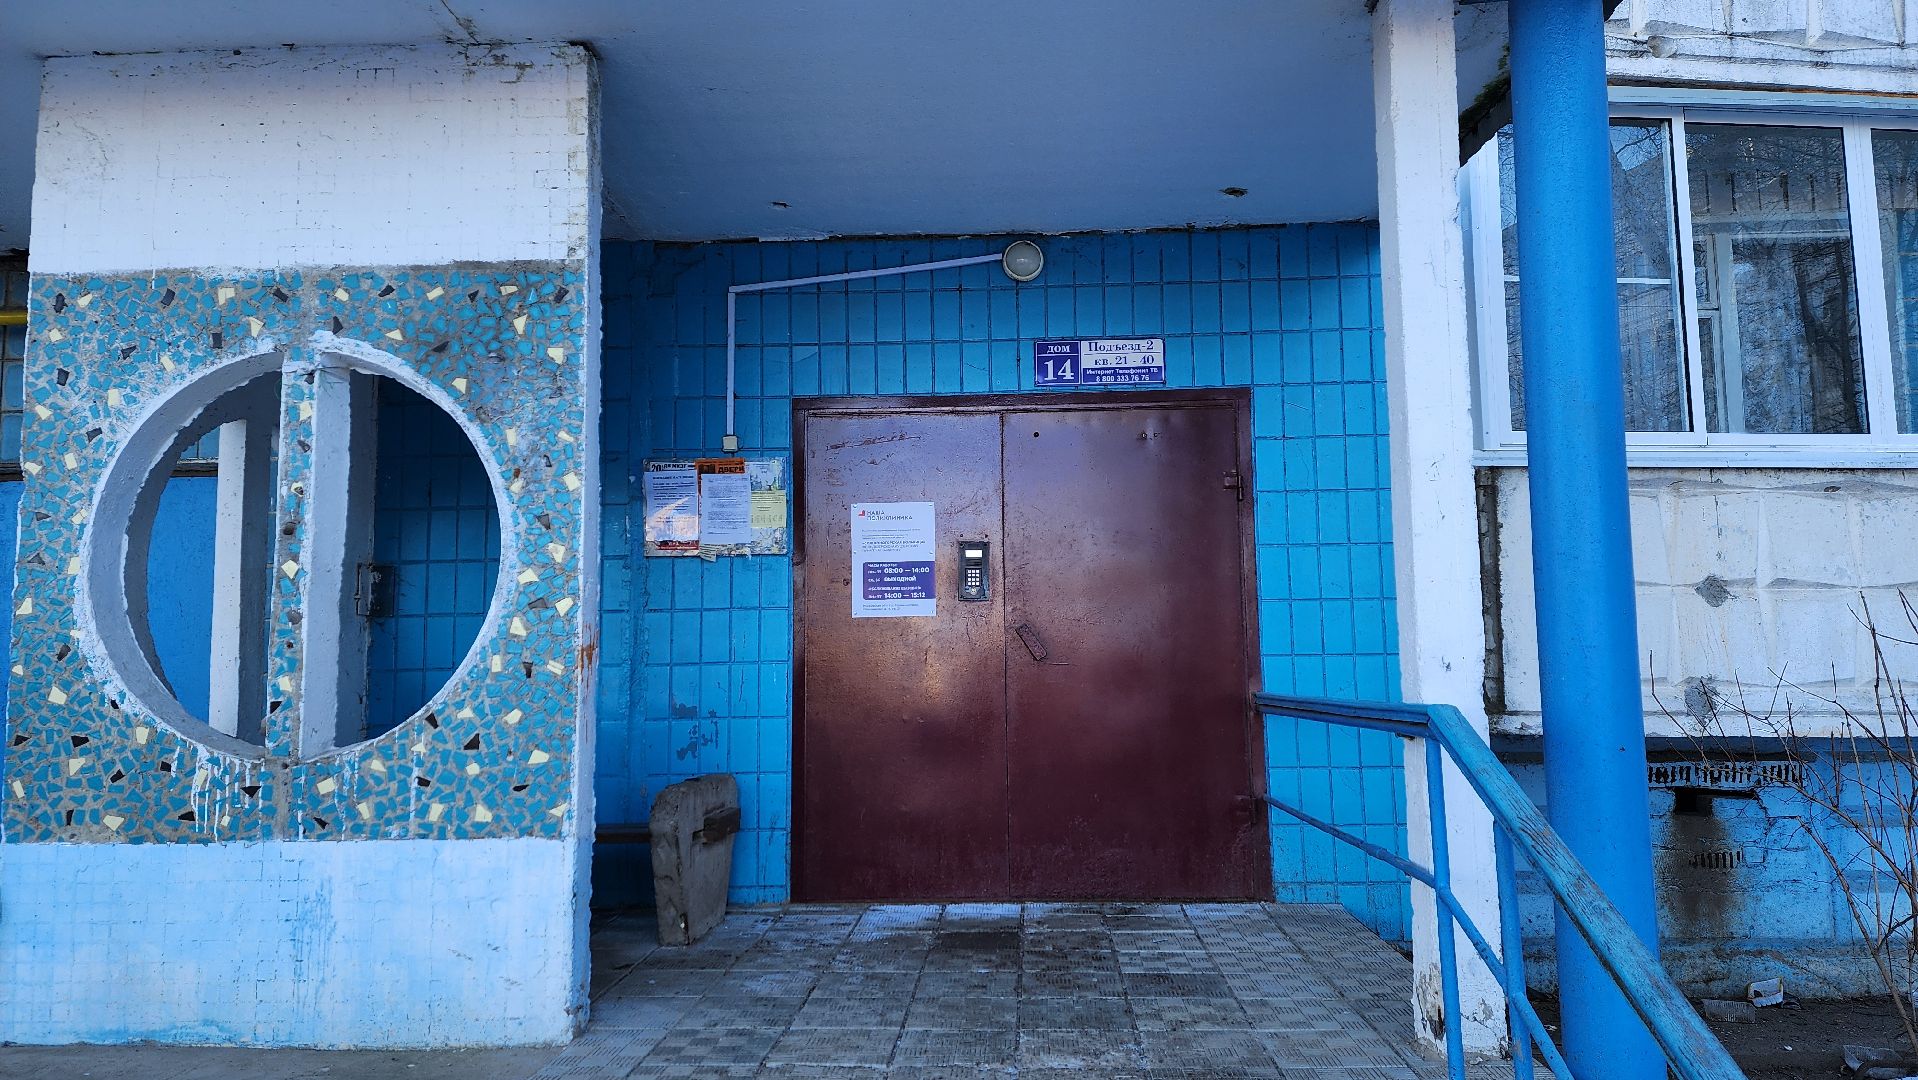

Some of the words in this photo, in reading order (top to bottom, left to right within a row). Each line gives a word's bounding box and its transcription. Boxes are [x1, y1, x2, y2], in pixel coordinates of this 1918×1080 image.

[1094, 358, 1112, 366] кв.
[1115, 355, 1127, 365] 21
[1140, 354, 1154, 365] 40
[1044, 358, 1075, 381] 14
[1115, 367, 1149, 375] Телефония
[1130, 374, 1139, 382] 76
